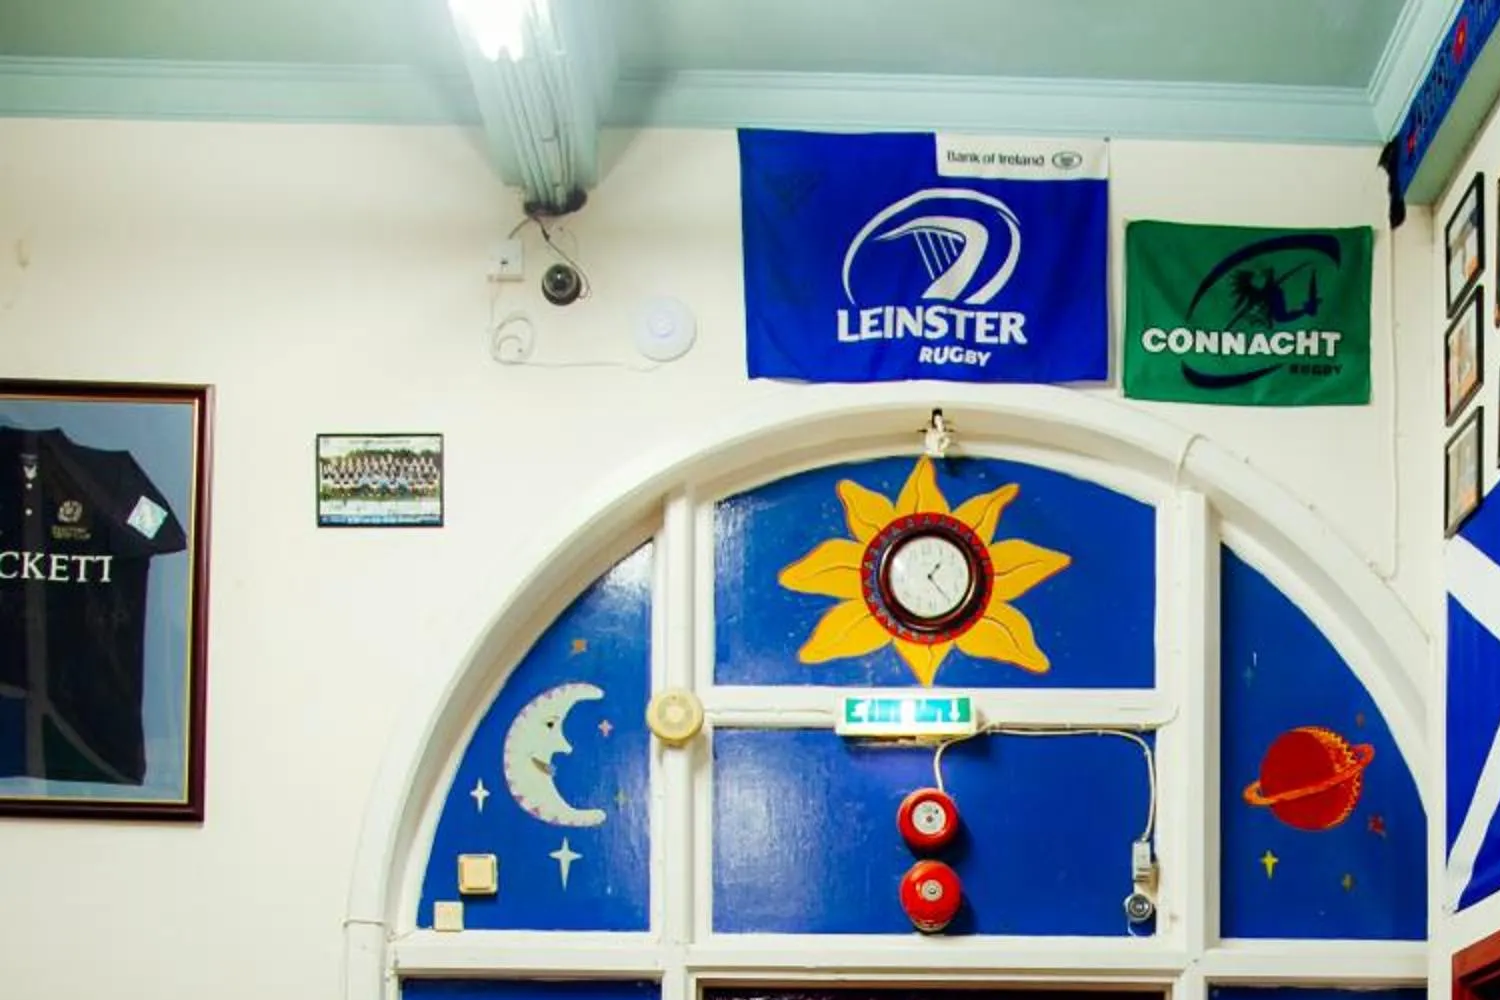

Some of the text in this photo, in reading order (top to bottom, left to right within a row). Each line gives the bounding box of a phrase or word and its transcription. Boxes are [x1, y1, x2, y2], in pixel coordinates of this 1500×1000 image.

[946, 149, 1046, 167] Bank of Ireland
[835, 304, 1028, 346] LEINSTER
[1141, 326, 1342, 358] CONNACHT
[918, 345, 992, 368] RUGBY
